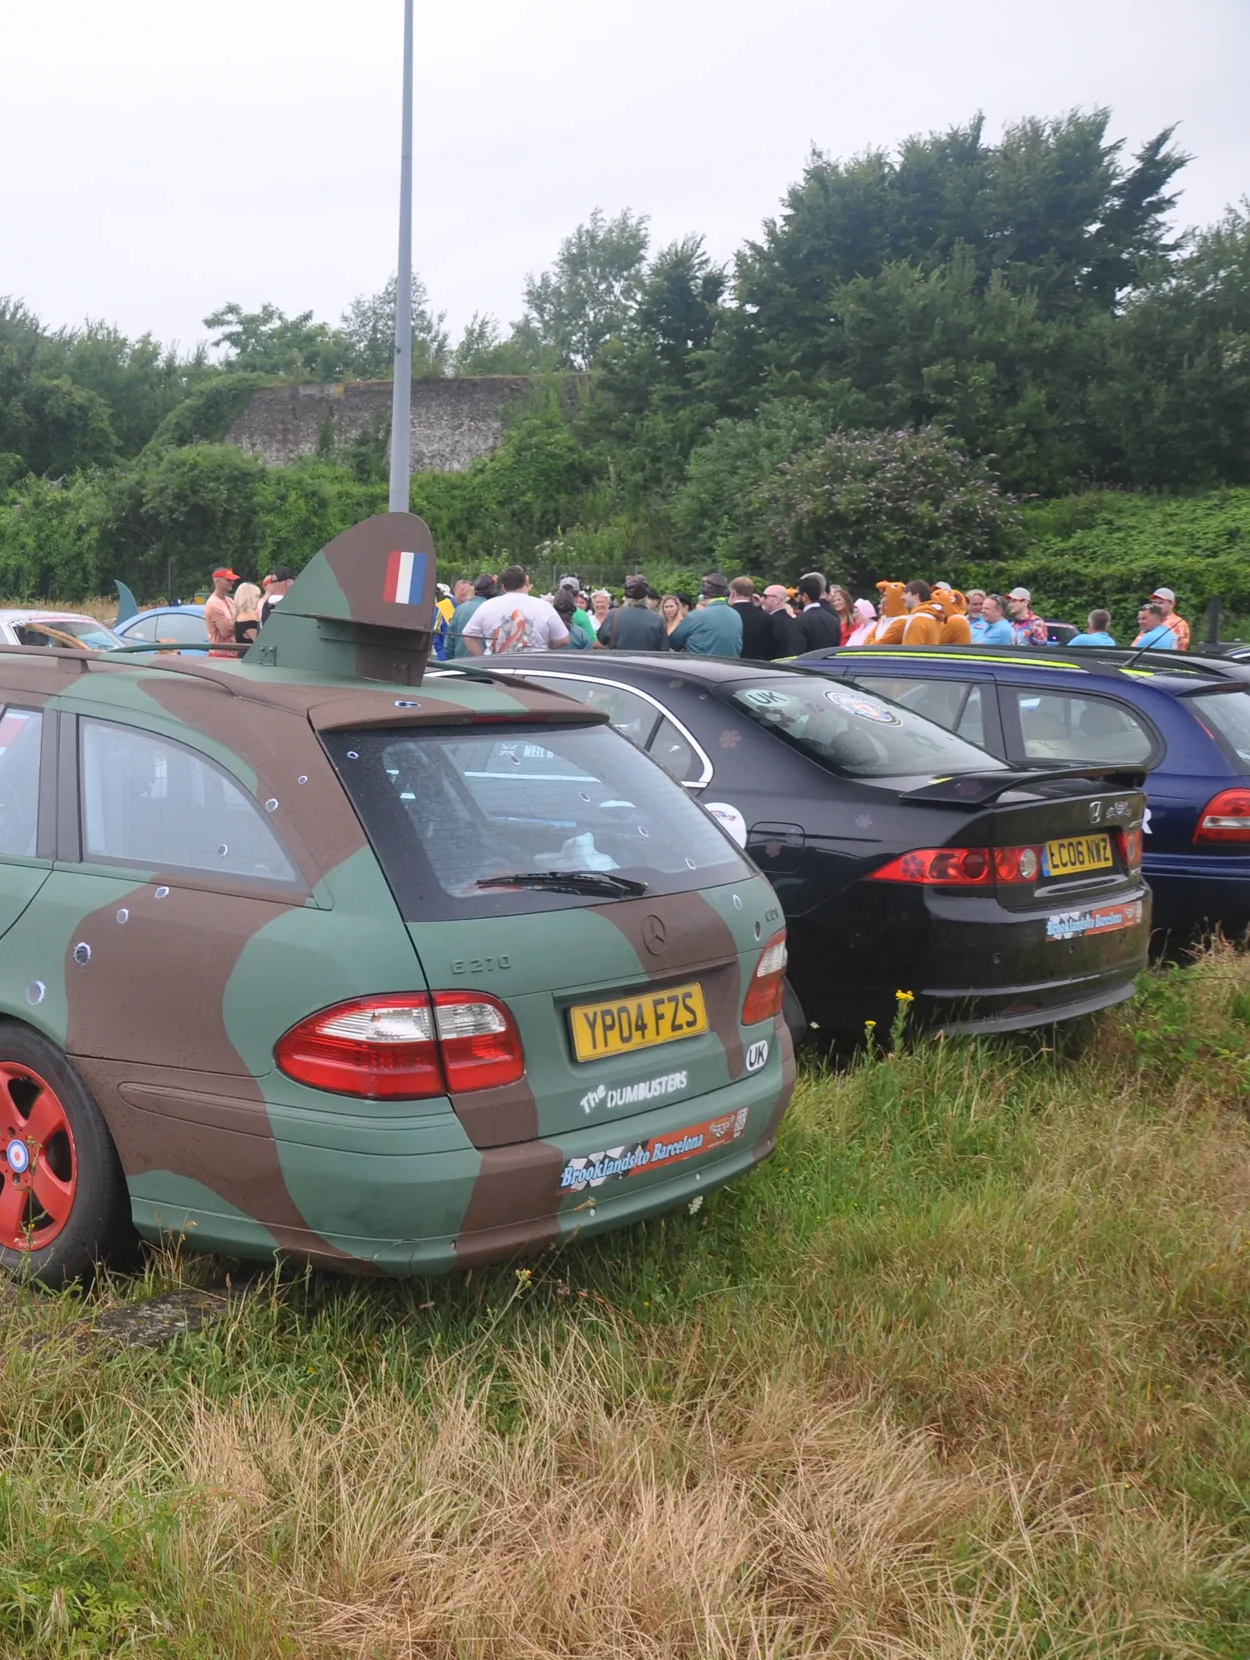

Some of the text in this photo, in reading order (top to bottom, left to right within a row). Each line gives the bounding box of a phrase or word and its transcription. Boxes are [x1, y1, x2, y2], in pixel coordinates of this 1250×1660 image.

[747, 690, 787, 705] UK
[583, 991, 698, 1050] YP04 FZS
[749, 1047, 766, 1067] UK
[580, 1070, 688, 1114] The DUMBUSTERS
[560, 1133, 704, 1187] Brooklands to Barcelona
